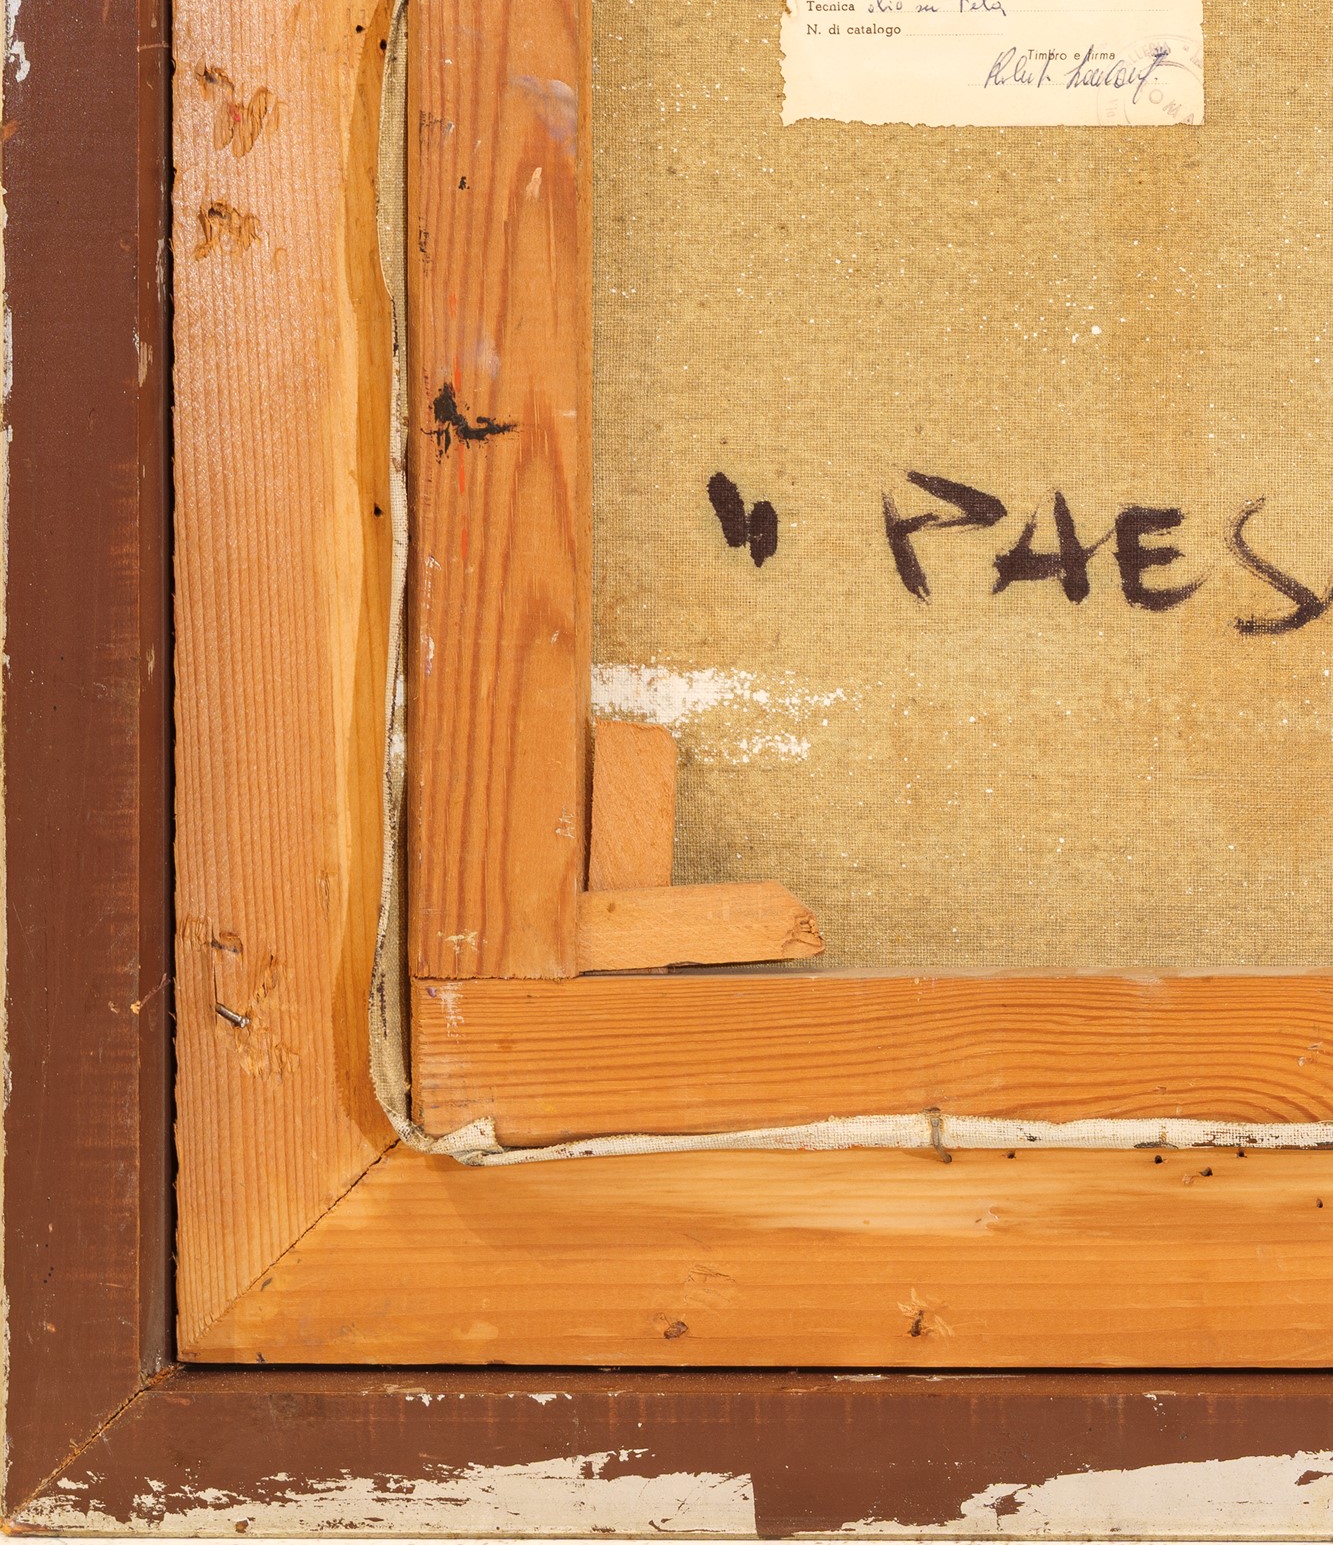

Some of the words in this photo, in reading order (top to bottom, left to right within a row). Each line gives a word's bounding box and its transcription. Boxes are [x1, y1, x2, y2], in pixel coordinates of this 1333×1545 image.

[806, 1, 855, 12] Tecnica
[806, 24, 821, 35] N.
[828, 24, 840, 35] di
[847, 24, 902, 38] catalogo
[1027, 49, 1067, 61] Timbro
[1073, 52, 1081, 60] e
